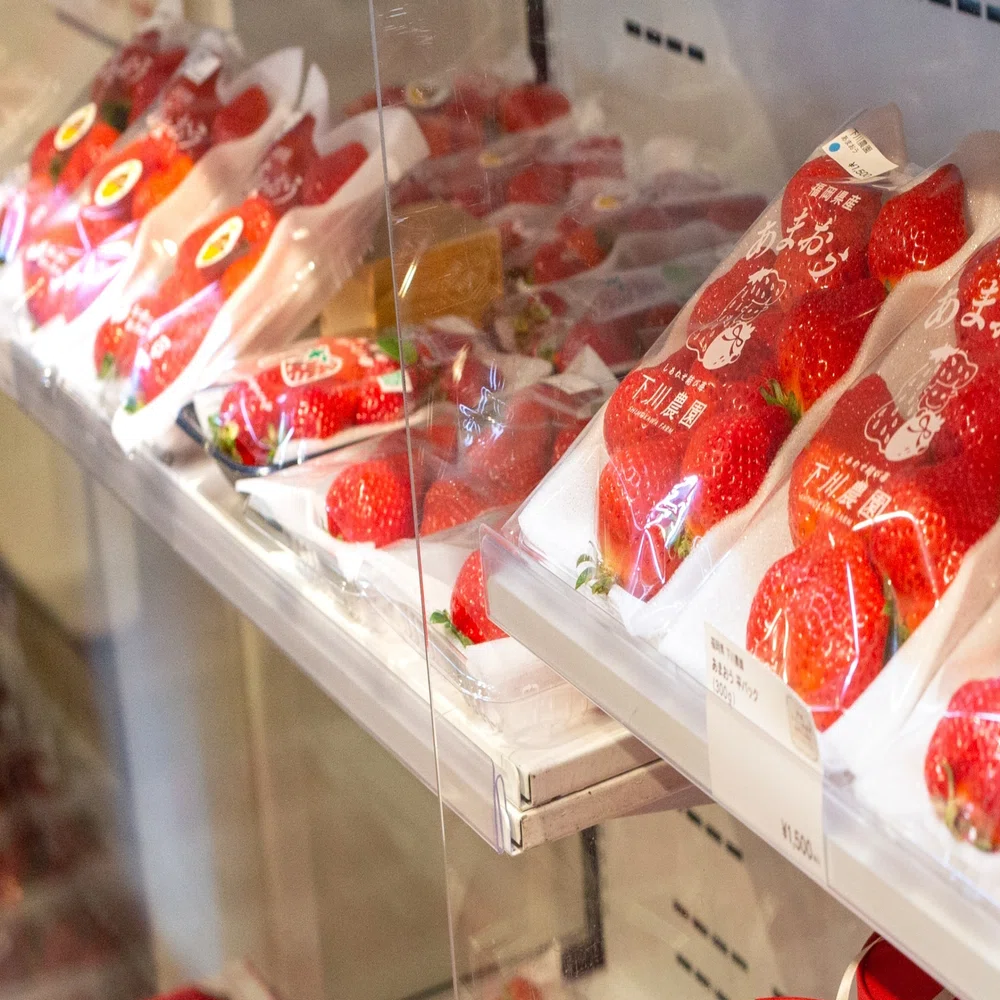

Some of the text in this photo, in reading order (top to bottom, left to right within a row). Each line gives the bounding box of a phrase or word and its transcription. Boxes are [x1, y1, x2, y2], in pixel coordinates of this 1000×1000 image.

[808, 182, 862, 212] 福岡県産
[745, 207, 850, 279] あまおう
[631, 373, 708, 430] 下川農園
[803, 461, 893, 521] 下川農園
